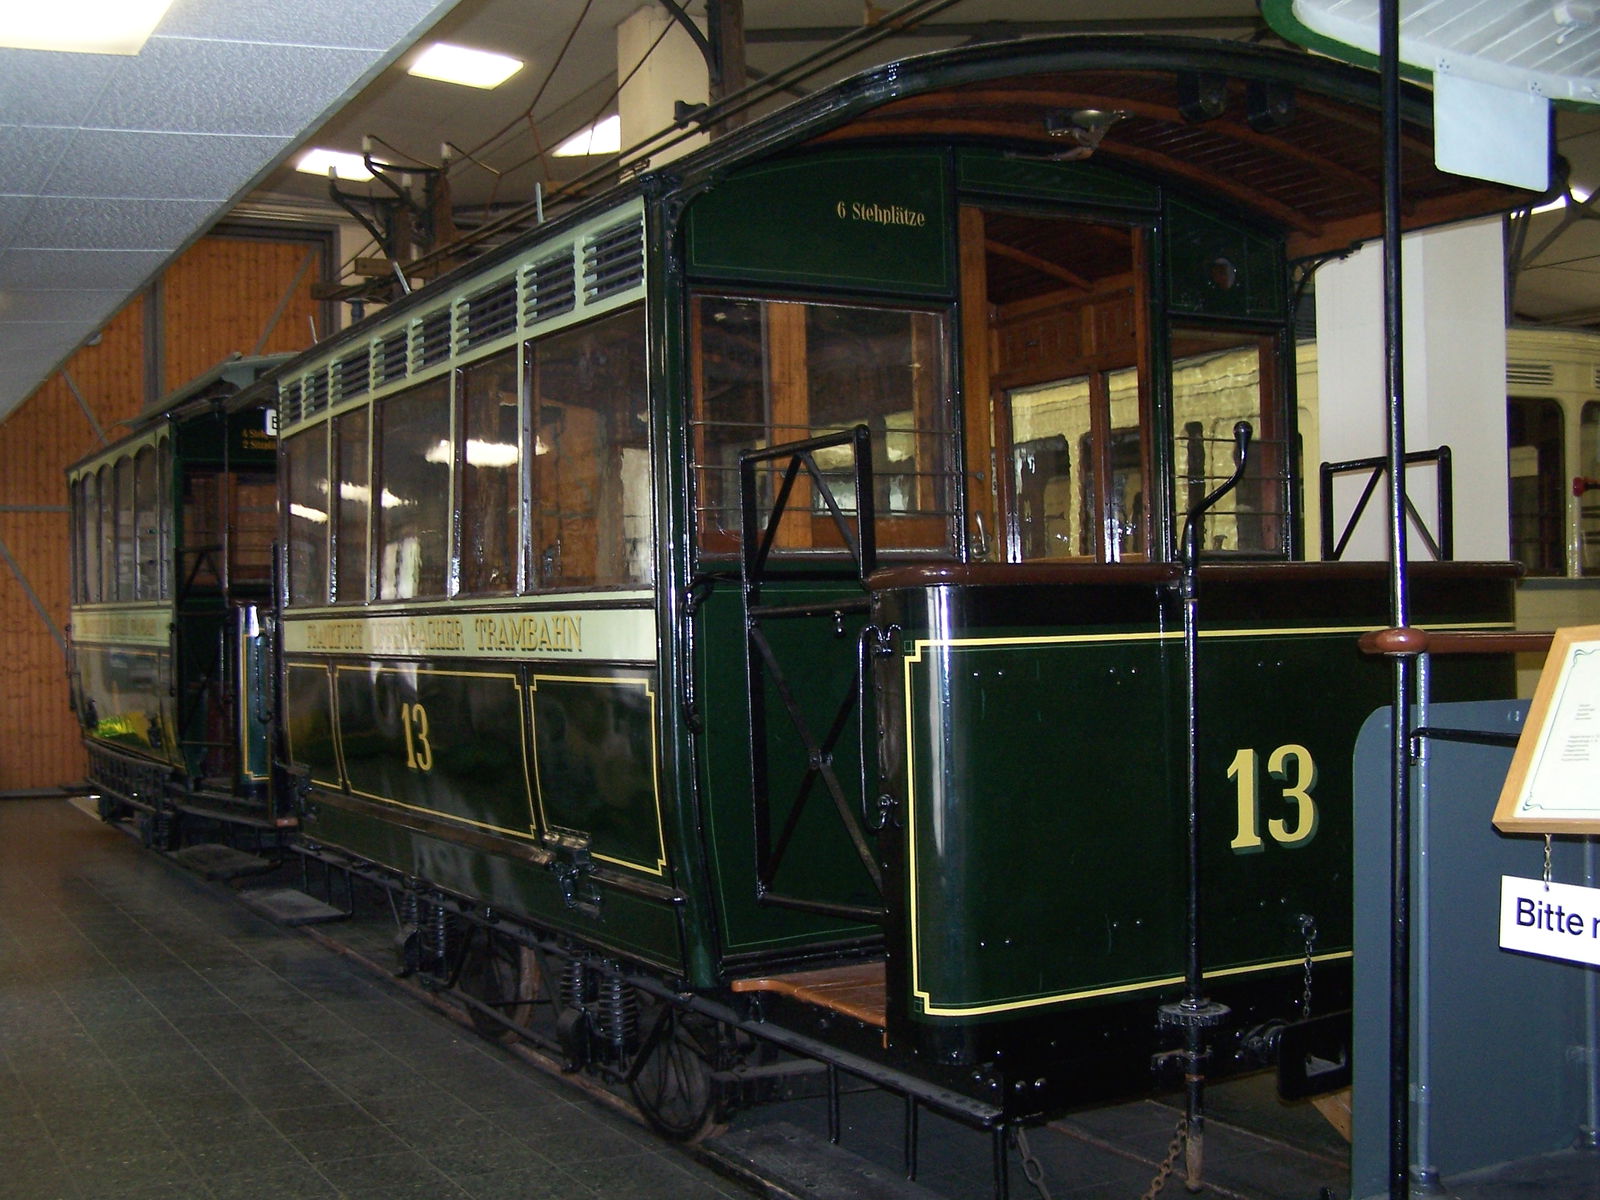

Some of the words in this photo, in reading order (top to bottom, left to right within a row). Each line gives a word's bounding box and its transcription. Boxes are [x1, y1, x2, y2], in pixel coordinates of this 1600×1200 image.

[837, 200, 846, 219] 6
[852, 202, 925, 227] Stehplätze
[475, 615, 582, 652] TRAMBAHN
[402, 703, 432, 770] 13
[1227, 744, 1319, 854] 13
[1516, 896, 1584, 936] Bitte
